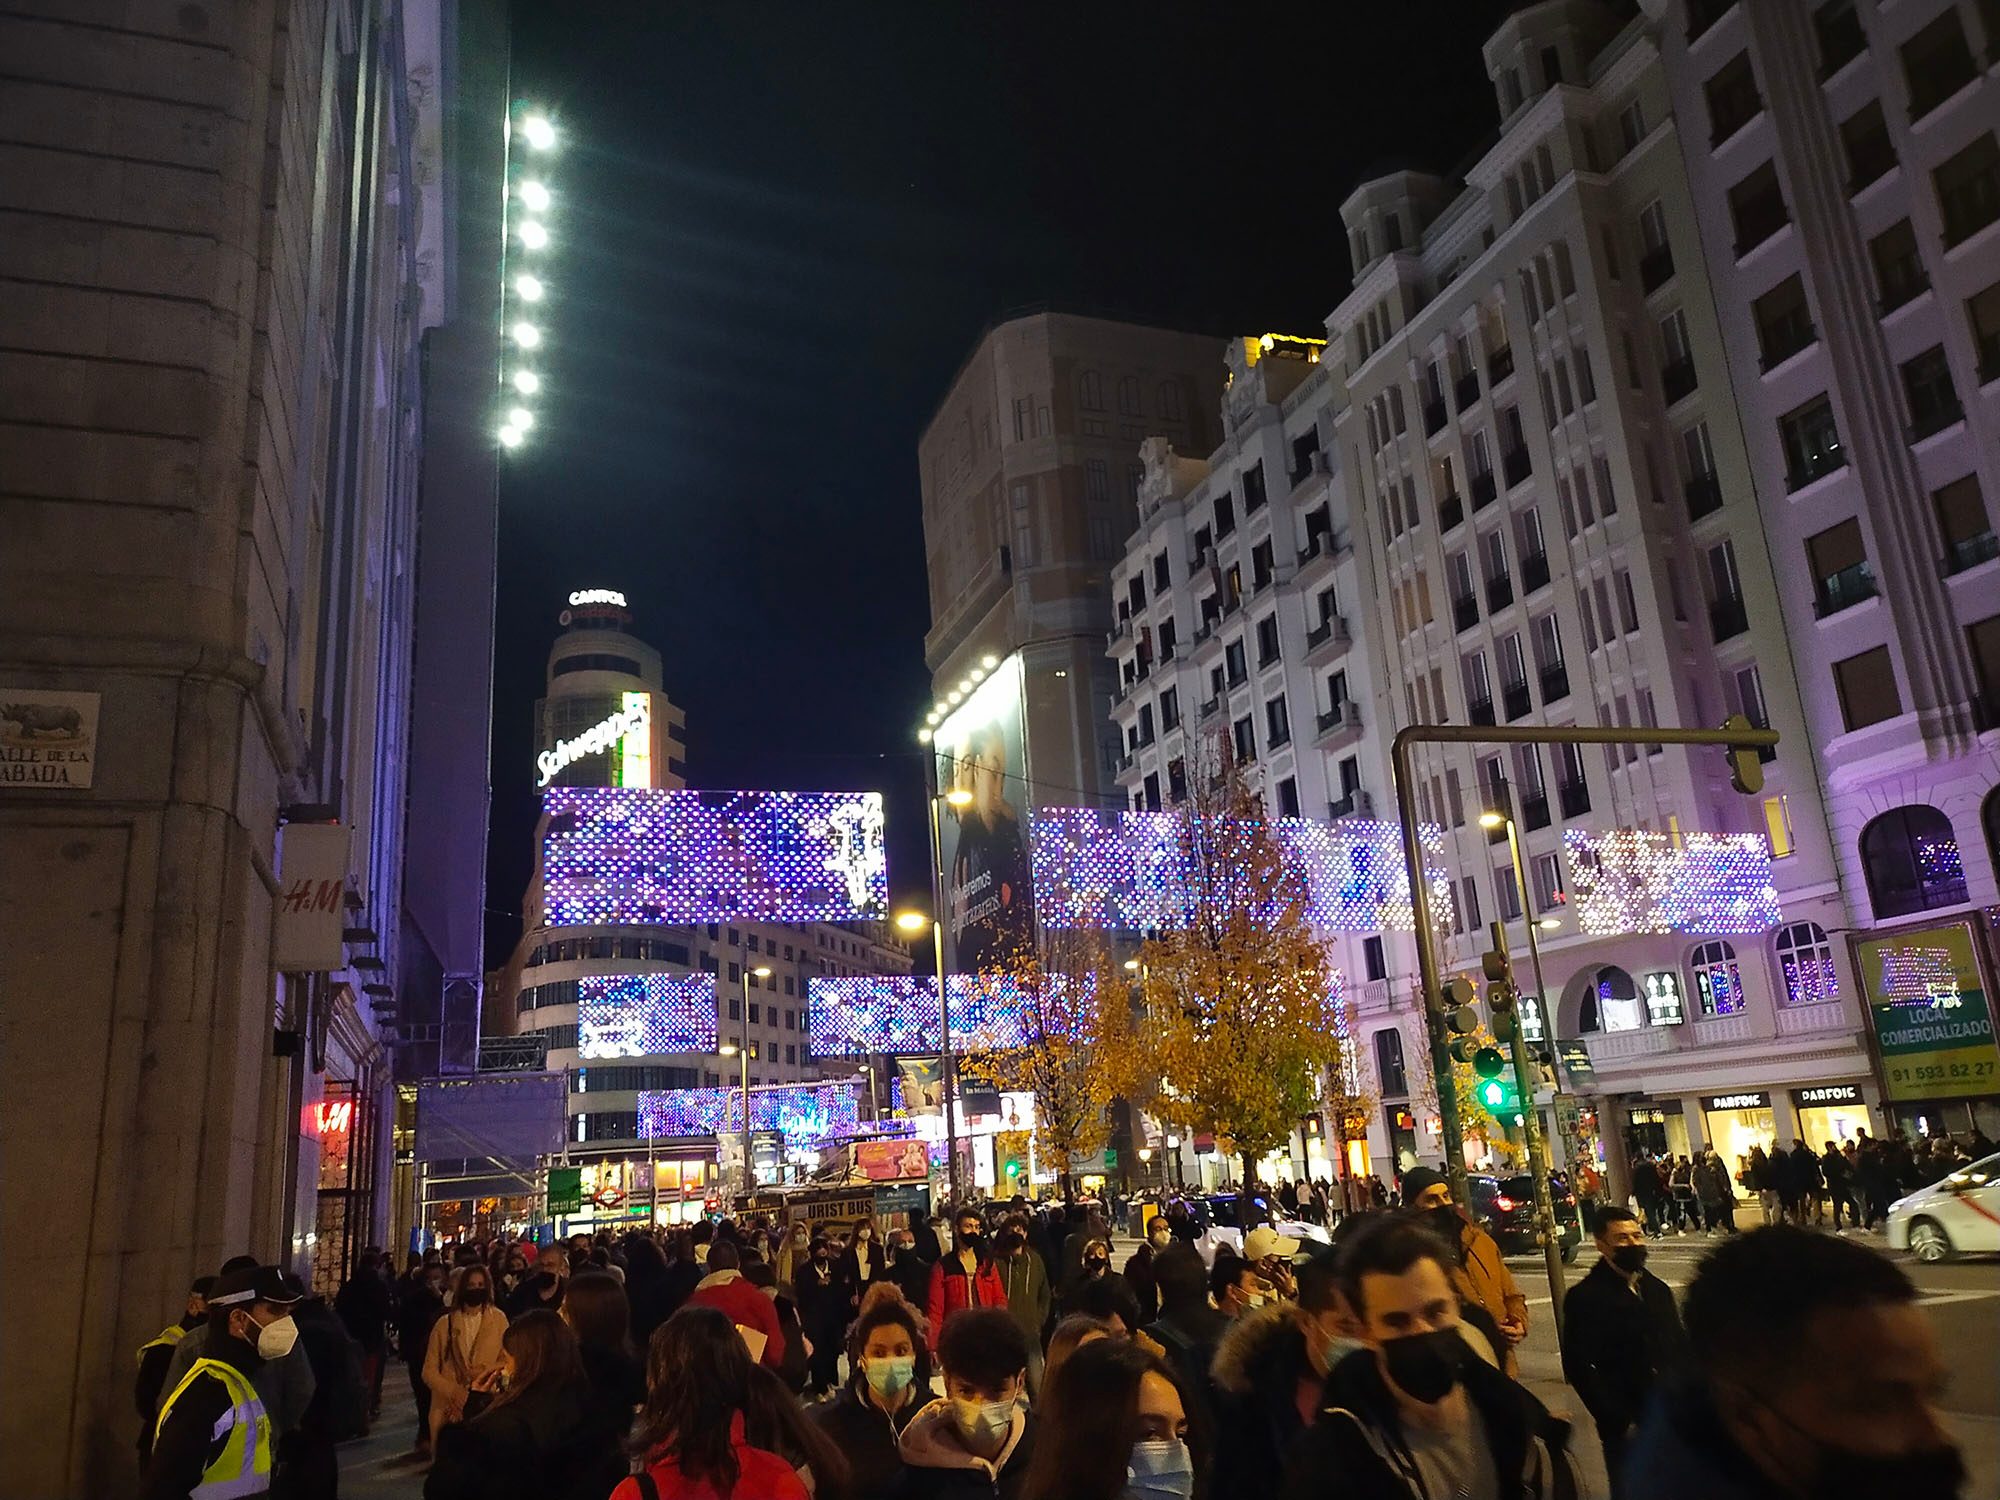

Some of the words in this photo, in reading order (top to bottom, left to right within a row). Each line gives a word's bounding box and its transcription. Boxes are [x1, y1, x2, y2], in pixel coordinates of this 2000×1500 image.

[0, 748, 40, 763] ALLE
[47, 750, 65, 762] DE
[69, 750, 89, 763] LA
[0, 764, 69, 783] ABADA
[282, 879, 343, 914] H&M
[1909, 1007, 1951, 1024] LOCAL
[1880, 1019, 1991, 1047] COMERCIALIZADO
[1892, 1069, 1910, 1082] 91
[1915, 1065, 1945, 1080] 593
[1974, 1062, 1994, 1076] 27
[808, 1202, 845, 1219] URIST
[847, 1200, 873, 1216] BUS
